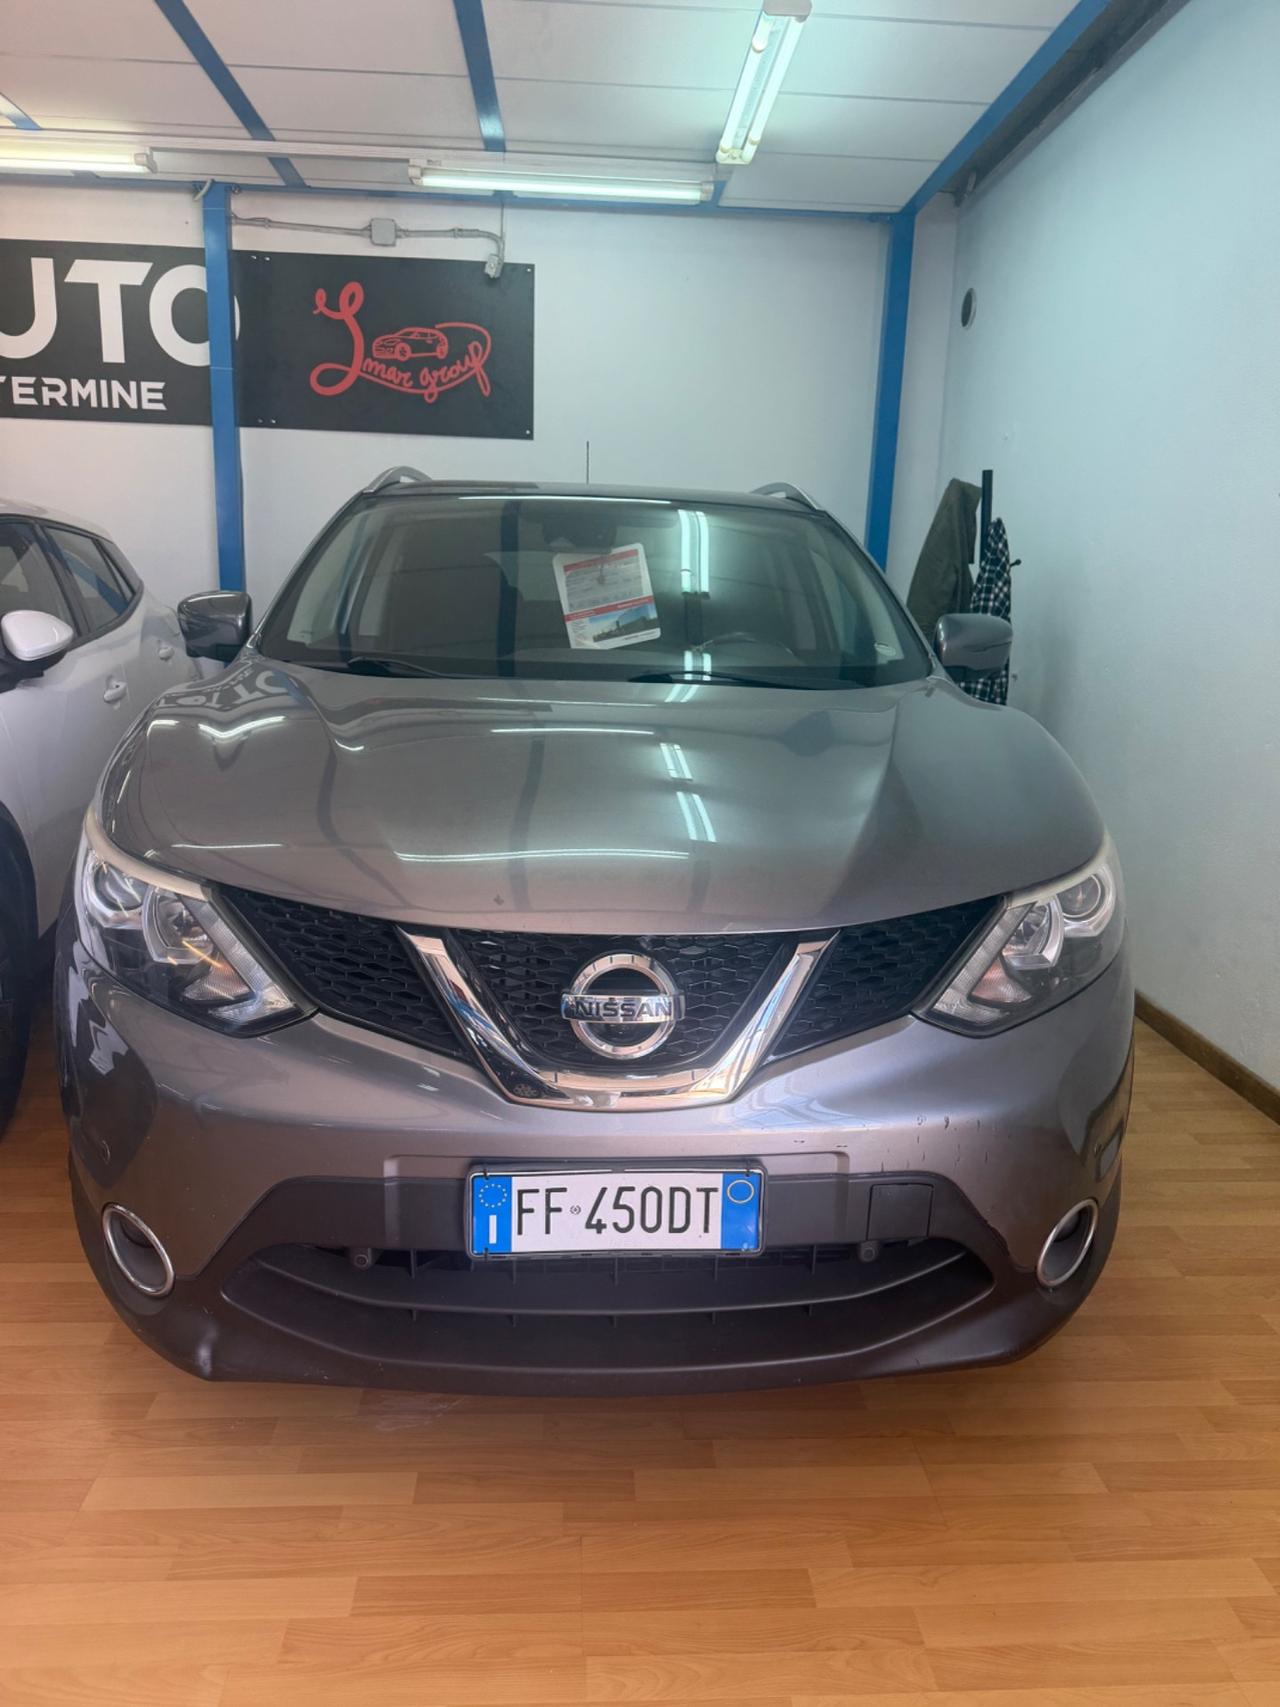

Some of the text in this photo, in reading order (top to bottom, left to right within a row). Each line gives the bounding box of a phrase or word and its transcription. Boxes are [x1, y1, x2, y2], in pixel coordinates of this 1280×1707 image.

[575, 1000, 672, 1018] NISSAN
[517, 1186, 719, 1236] FF 450DT
[488, 1214, 497, 1244] I
